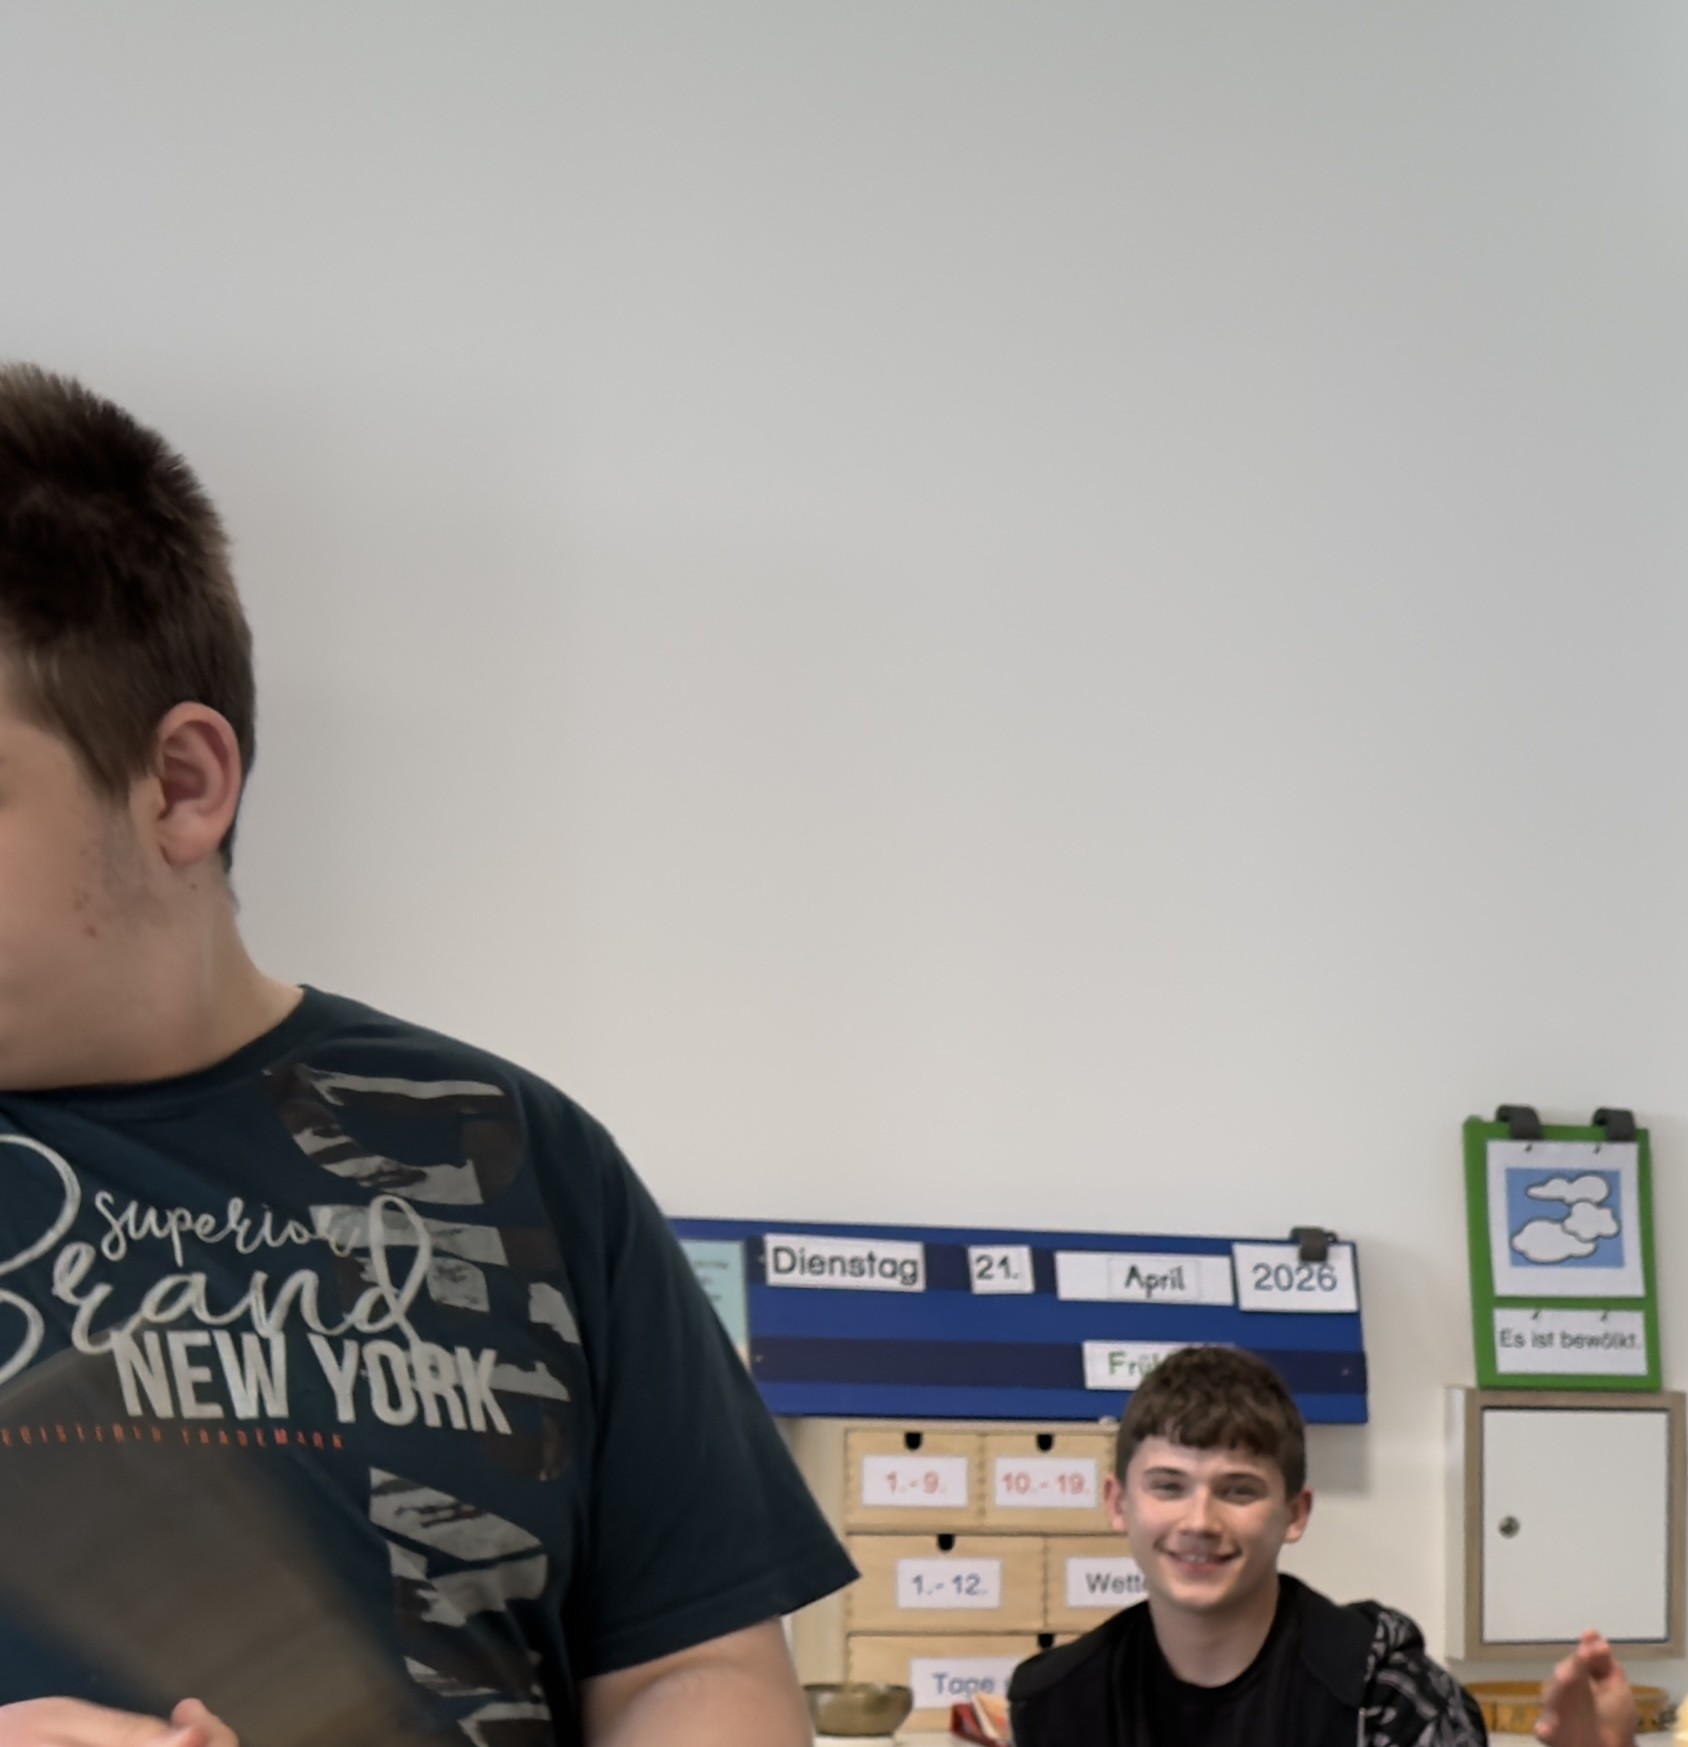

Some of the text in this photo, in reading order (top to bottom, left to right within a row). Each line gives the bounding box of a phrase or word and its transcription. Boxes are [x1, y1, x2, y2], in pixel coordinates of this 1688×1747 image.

[772, 1246, 1337, 1298] Dienstag 21. April 2026
[1500, 1328, 1525, 1348] Es
[1531, 1331, 1554, 1349] ist
[112, 1330, 512, 1435] NEW YORK
[0, 1423, 163, 1447] EGISTERED
[931, 1672, 995, 1697] Tage
